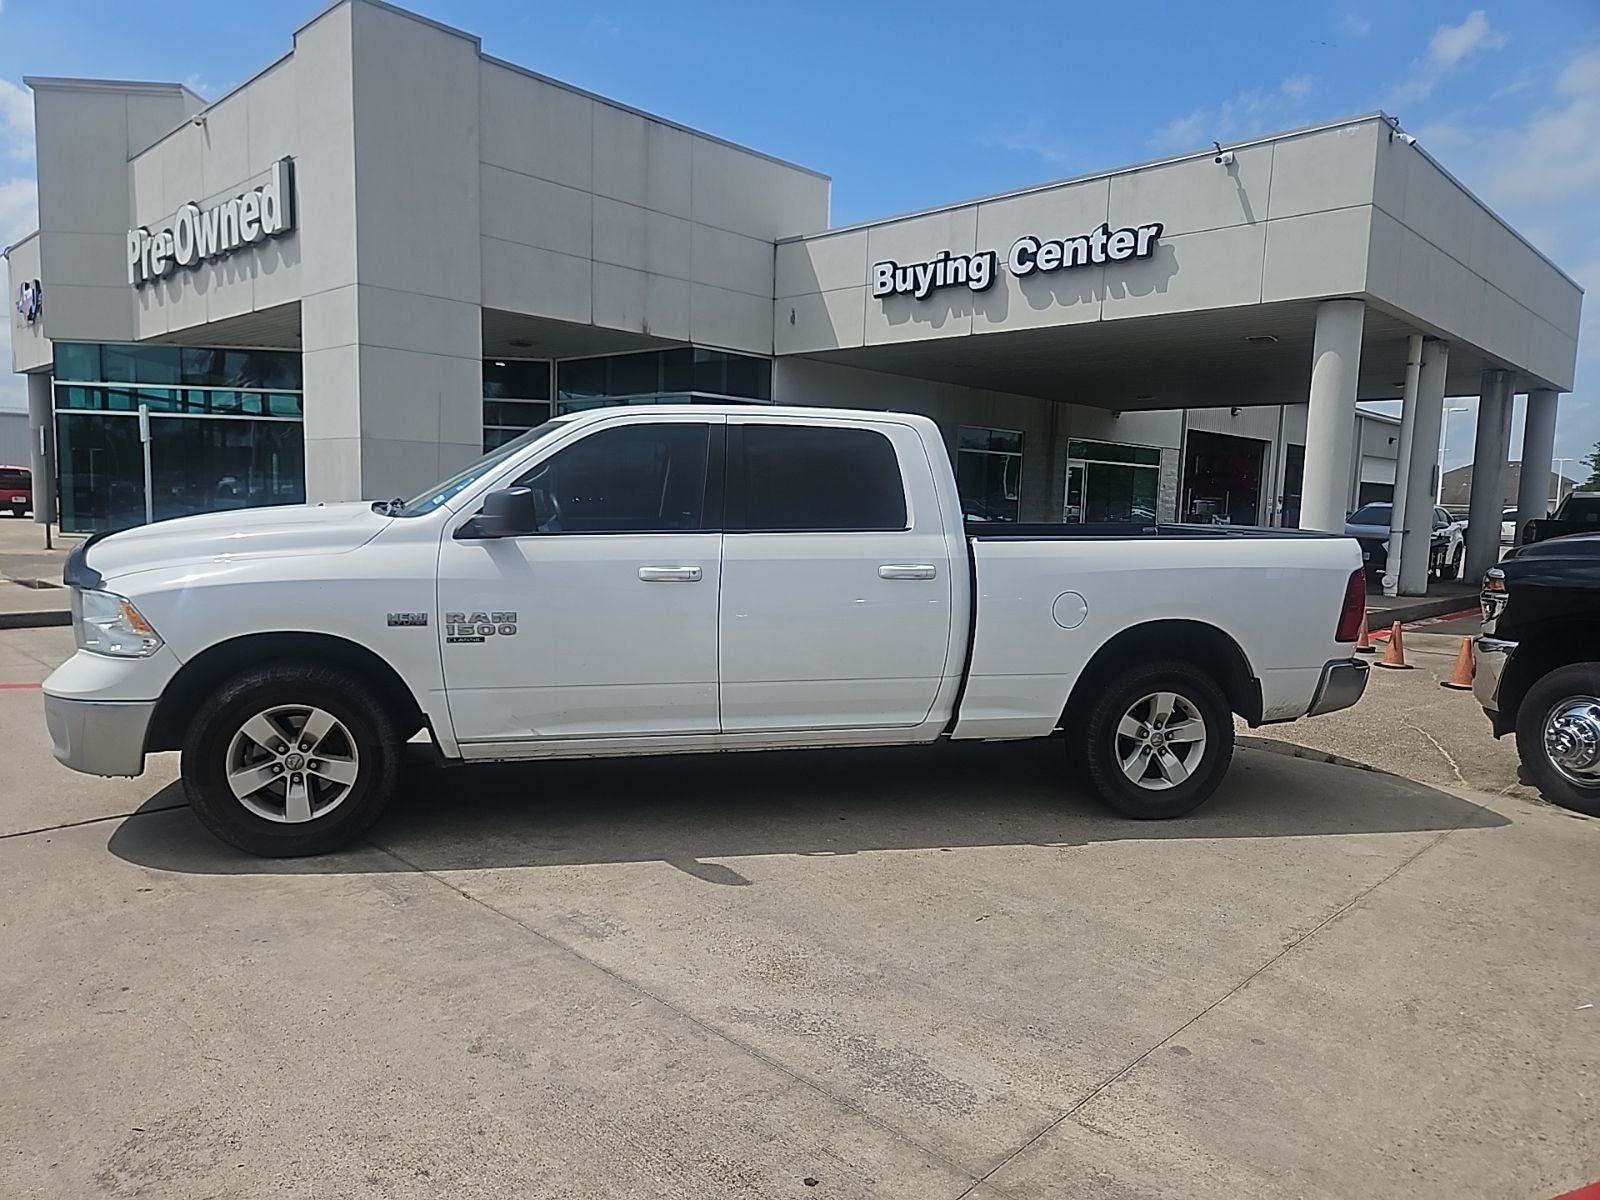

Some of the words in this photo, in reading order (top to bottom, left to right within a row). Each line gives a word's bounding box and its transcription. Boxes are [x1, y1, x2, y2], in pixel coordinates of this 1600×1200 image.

[127, 160, 288, 285] Pre-Owned
[873, 251, 997, 299] Buying
[1009, 223, 1163, 277] Center
[446, 612, 517, 623] RAM
[446, 624, 517, 636] 1500
